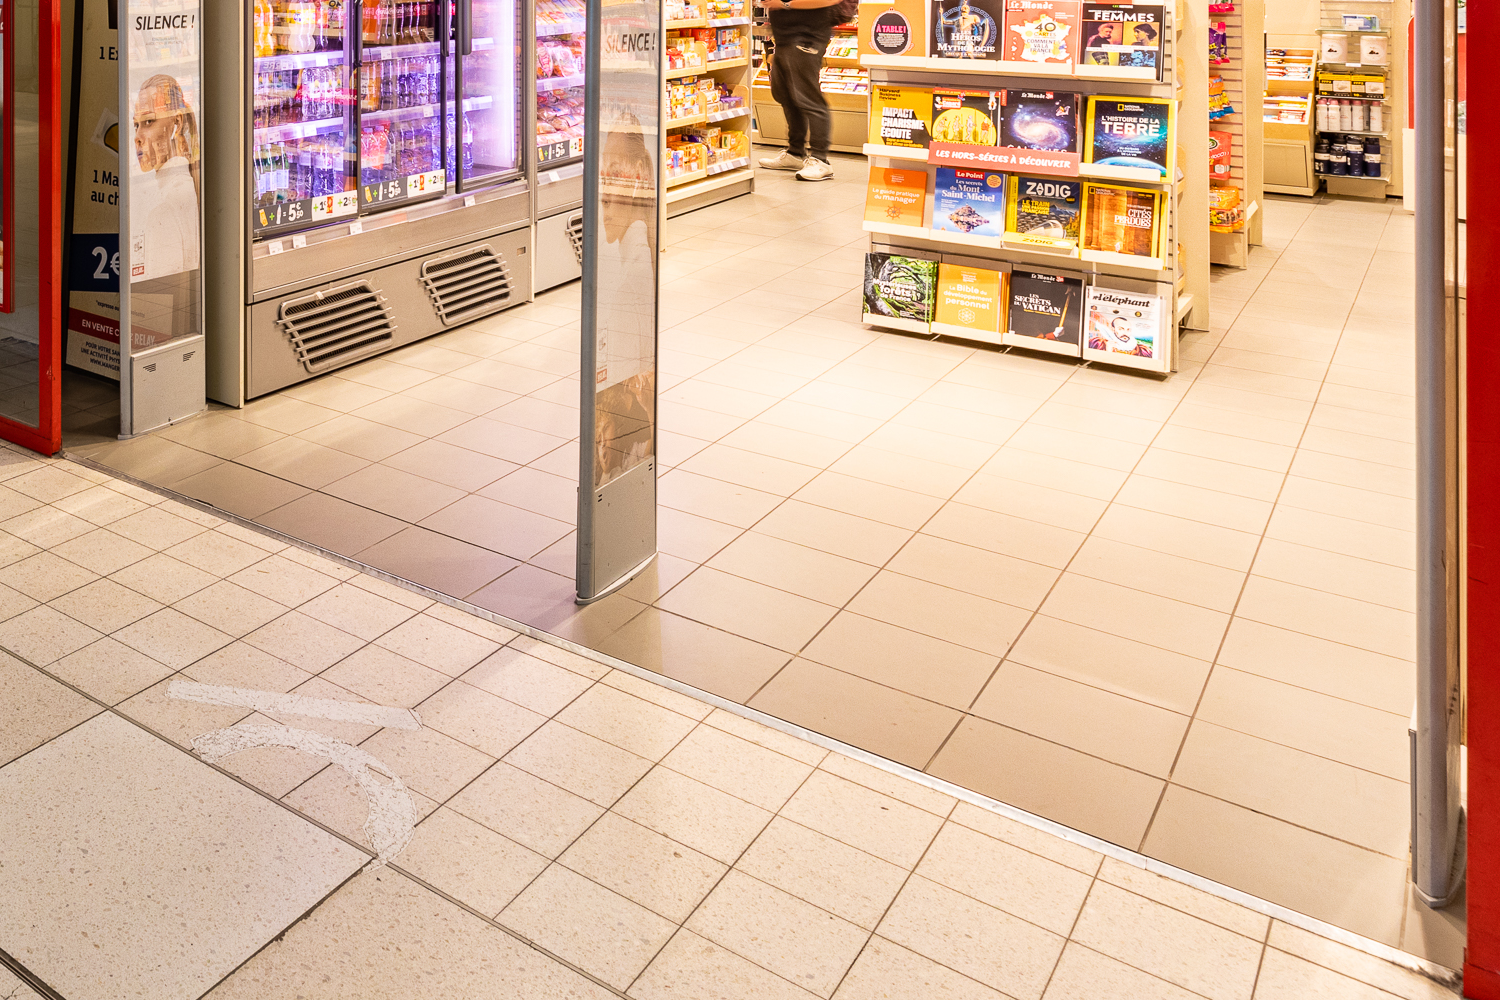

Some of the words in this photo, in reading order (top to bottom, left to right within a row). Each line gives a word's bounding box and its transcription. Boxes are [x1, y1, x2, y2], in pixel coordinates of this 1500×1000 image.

[1009, 1, 1019, 9] Le
[1020, 0, 1054, 10] Monde
[135, 14, 188, 31] SILENCE
[1094, 12, 1155, 23] FEMMES
[876, 23, 882, 33] À
[1034, 22, 1056, 32] 40
[605, 33, 650, 54] SILENCE
[99, 46, 105, 60] 1
[882, 107, 914, 119] IMPACT
[1101, 115, 1138, 124] L'HISTOIRE
[881, 117, 925, 130] CHARISME
[1101, 121, 1161, 137] TERRE
[936, 149, 950, 158] LES
[951, 150, 1009, 164] HORS-SÉRIES
[1010, 154, 1017, 164] À
[1019, 155, 1071, 168] DÉCOUVRIR
[92, 169, 99, 184] 1
[965, 179, 983, 187] secrets
[90, 190, 105, 203] au
[879, 188, 895, 196] guide
[895, 190, 920, 199] pratique
[882, 194, 917, 205] manager
[941, 190, 996, 203] Saint-Michel
[1031, 200, 1050, 208] TRAIN
[1127, 208, 1152, 219] CITÉS
[1113, 214, 1152, 228] PERDUES
[1037, 274, 1056, 282] Monde
[879, 284, 912, 298] forêts
[956, 283, 979, 295] Bible
[943, 290, 993, 303] développement
[1014, 294, 1052, 306] SECRETS
[945, 297, 990, 310] personnel
[1022, 301, 1061, 315] VATICAN
[81, 319, 91, 329] EN
[91, 321, 114, 335] VENTE
[85, 341, 97, 349] POUR
[97, 344, 111, 353] VOTRE
[80, 347, 90, 355] UNE
[89, 349, 109, 361] ACTIVITÉ
